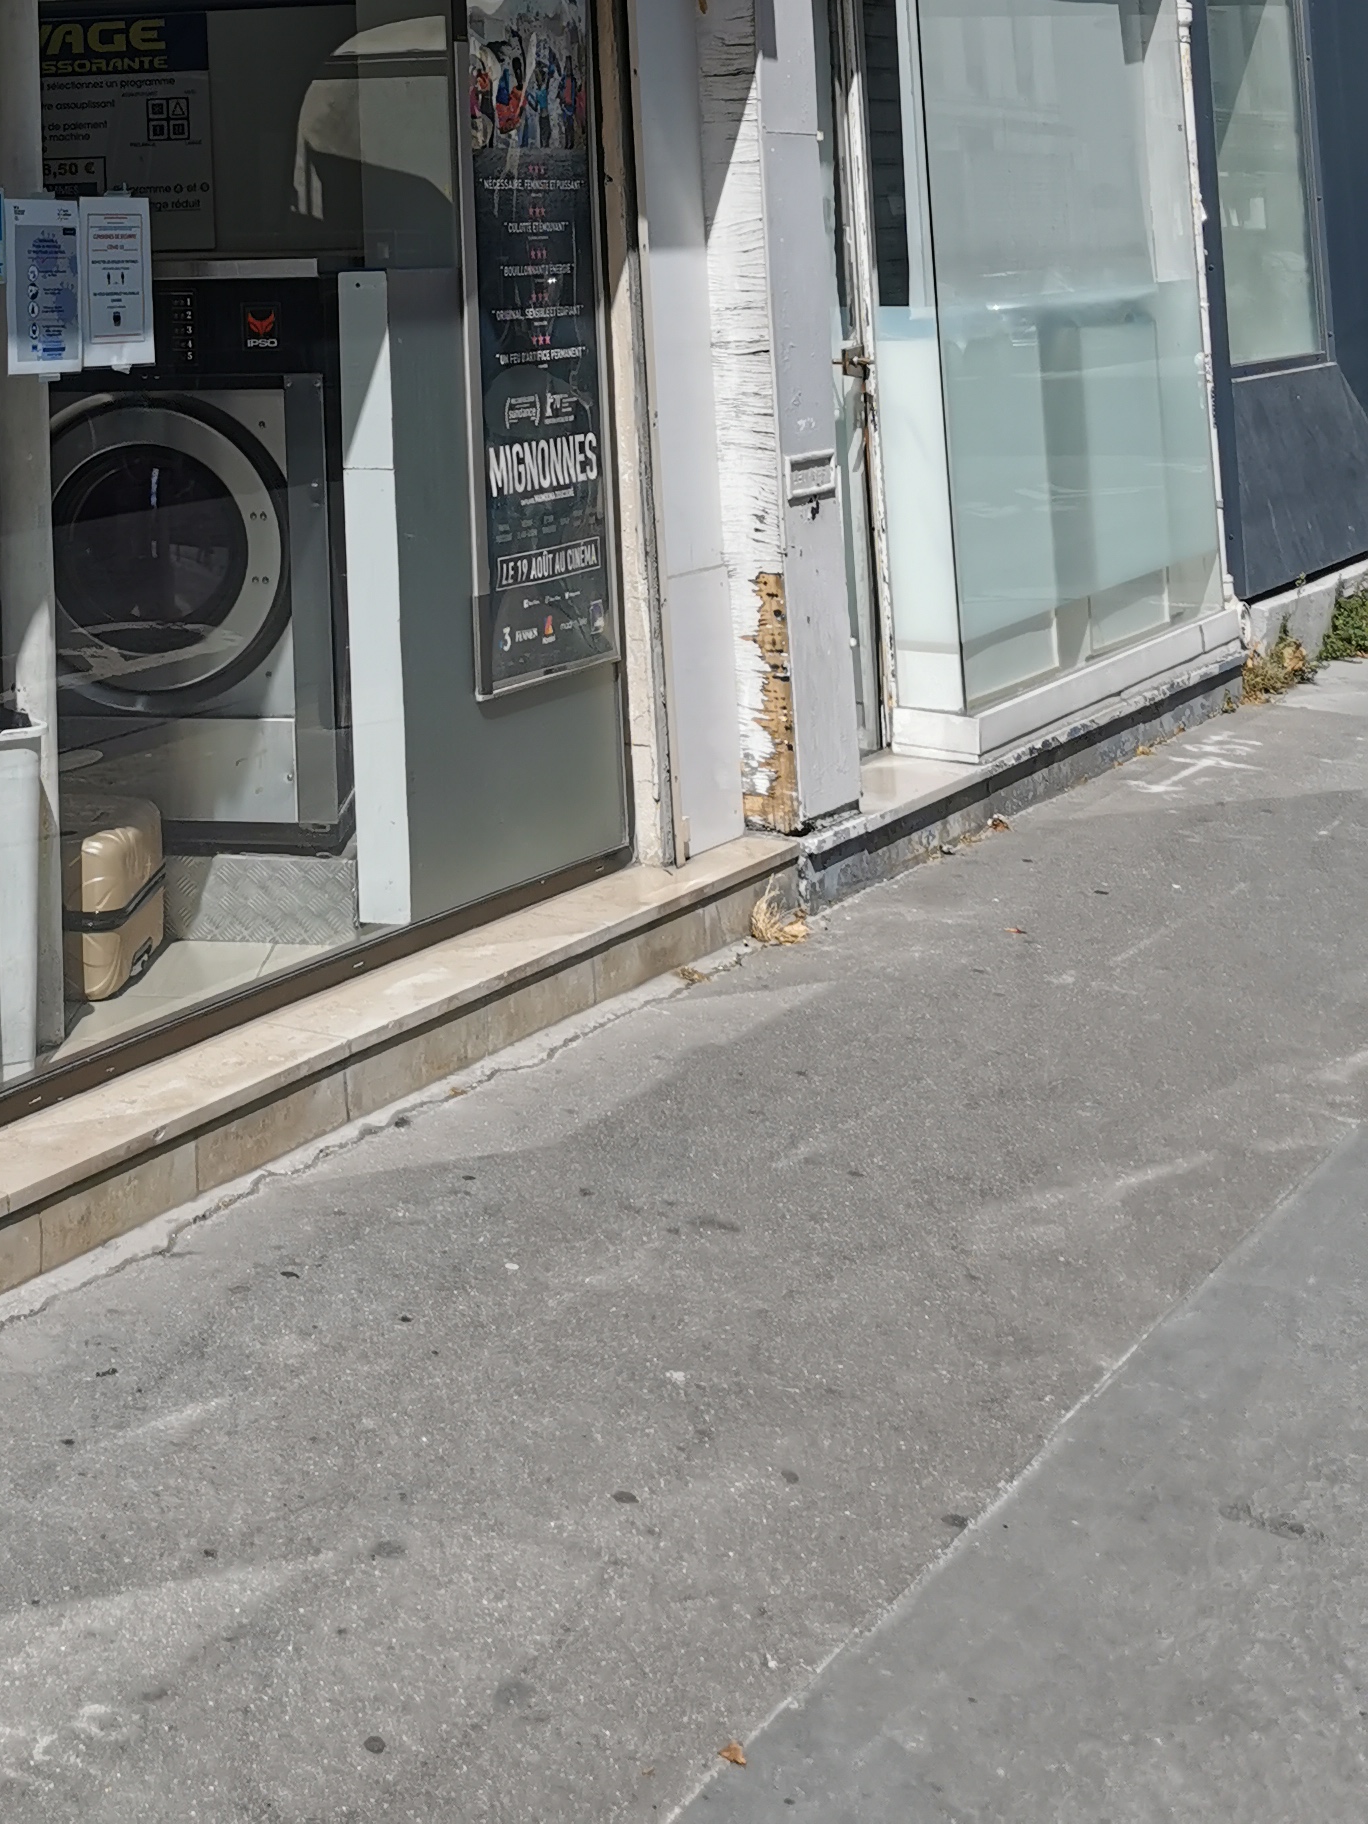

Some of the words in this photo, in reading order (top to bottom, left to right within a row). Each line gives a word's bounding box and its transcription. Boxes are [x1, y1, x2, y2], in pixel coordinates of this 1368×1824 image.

[42, 56, 169, 75] SSORANTE
[119, 78, 176, 90] programme
[246, 338, 278, 348] IPSO
[488, 432, 598, 498] MIGNONNES
[502, 561, 515, 585] LE
[516, 558, 529, 581] 19
[529, 550, 553, 580] AOÛT
[554, 550, 566, 574] AU
[566, 541, 598, 571] CINÉMA
